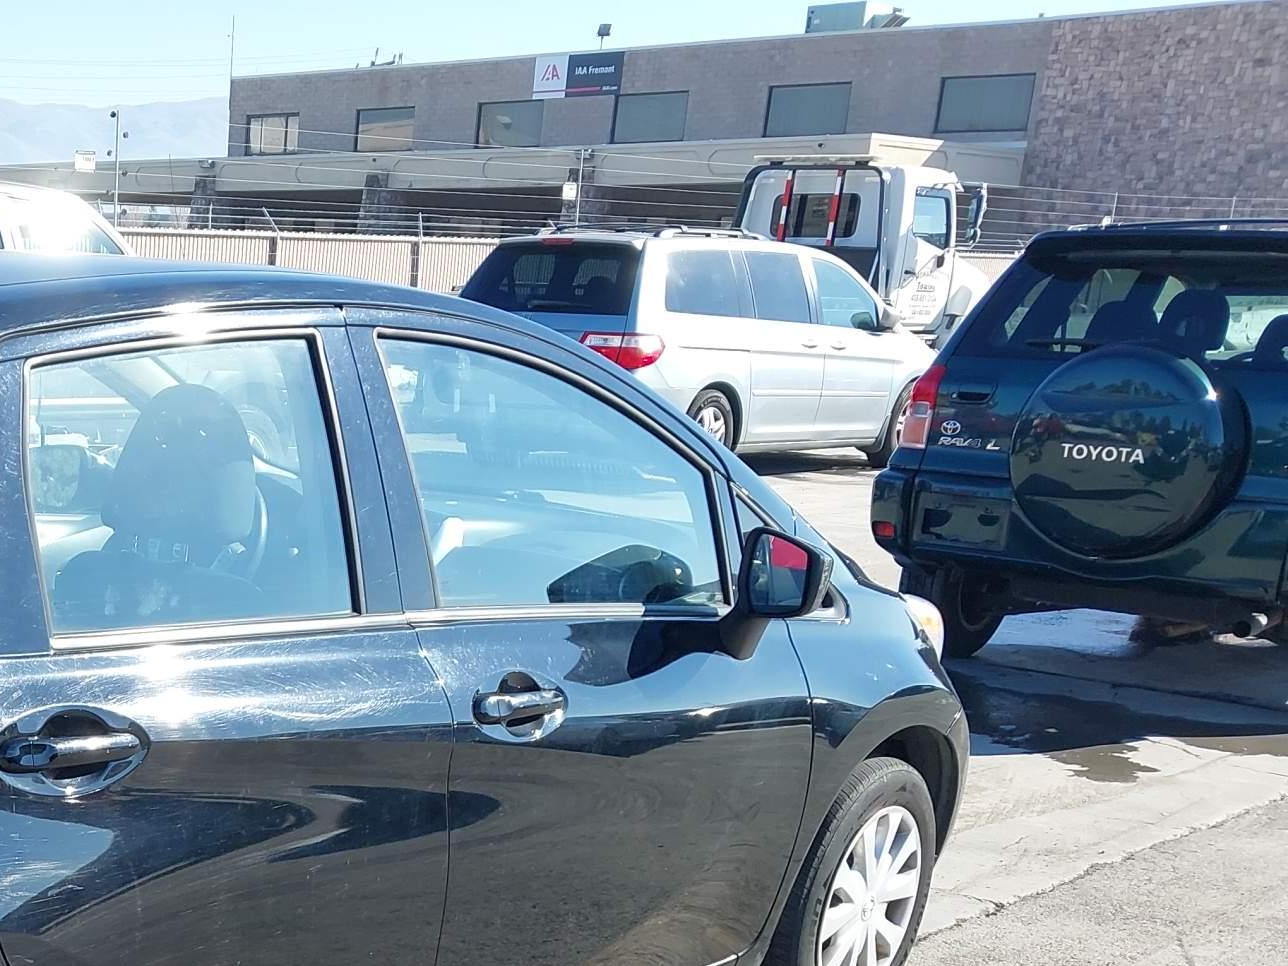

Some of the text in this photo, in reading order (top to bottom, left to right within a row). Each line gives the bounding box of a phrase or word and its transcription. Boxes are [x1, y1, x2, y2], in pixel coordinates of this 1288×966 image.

[575, 65, 615, 75] IAA Fremont
[938, 436, 1001, 450] RAV4 L
[1061, 443, 1145, 465] TOYOTA
